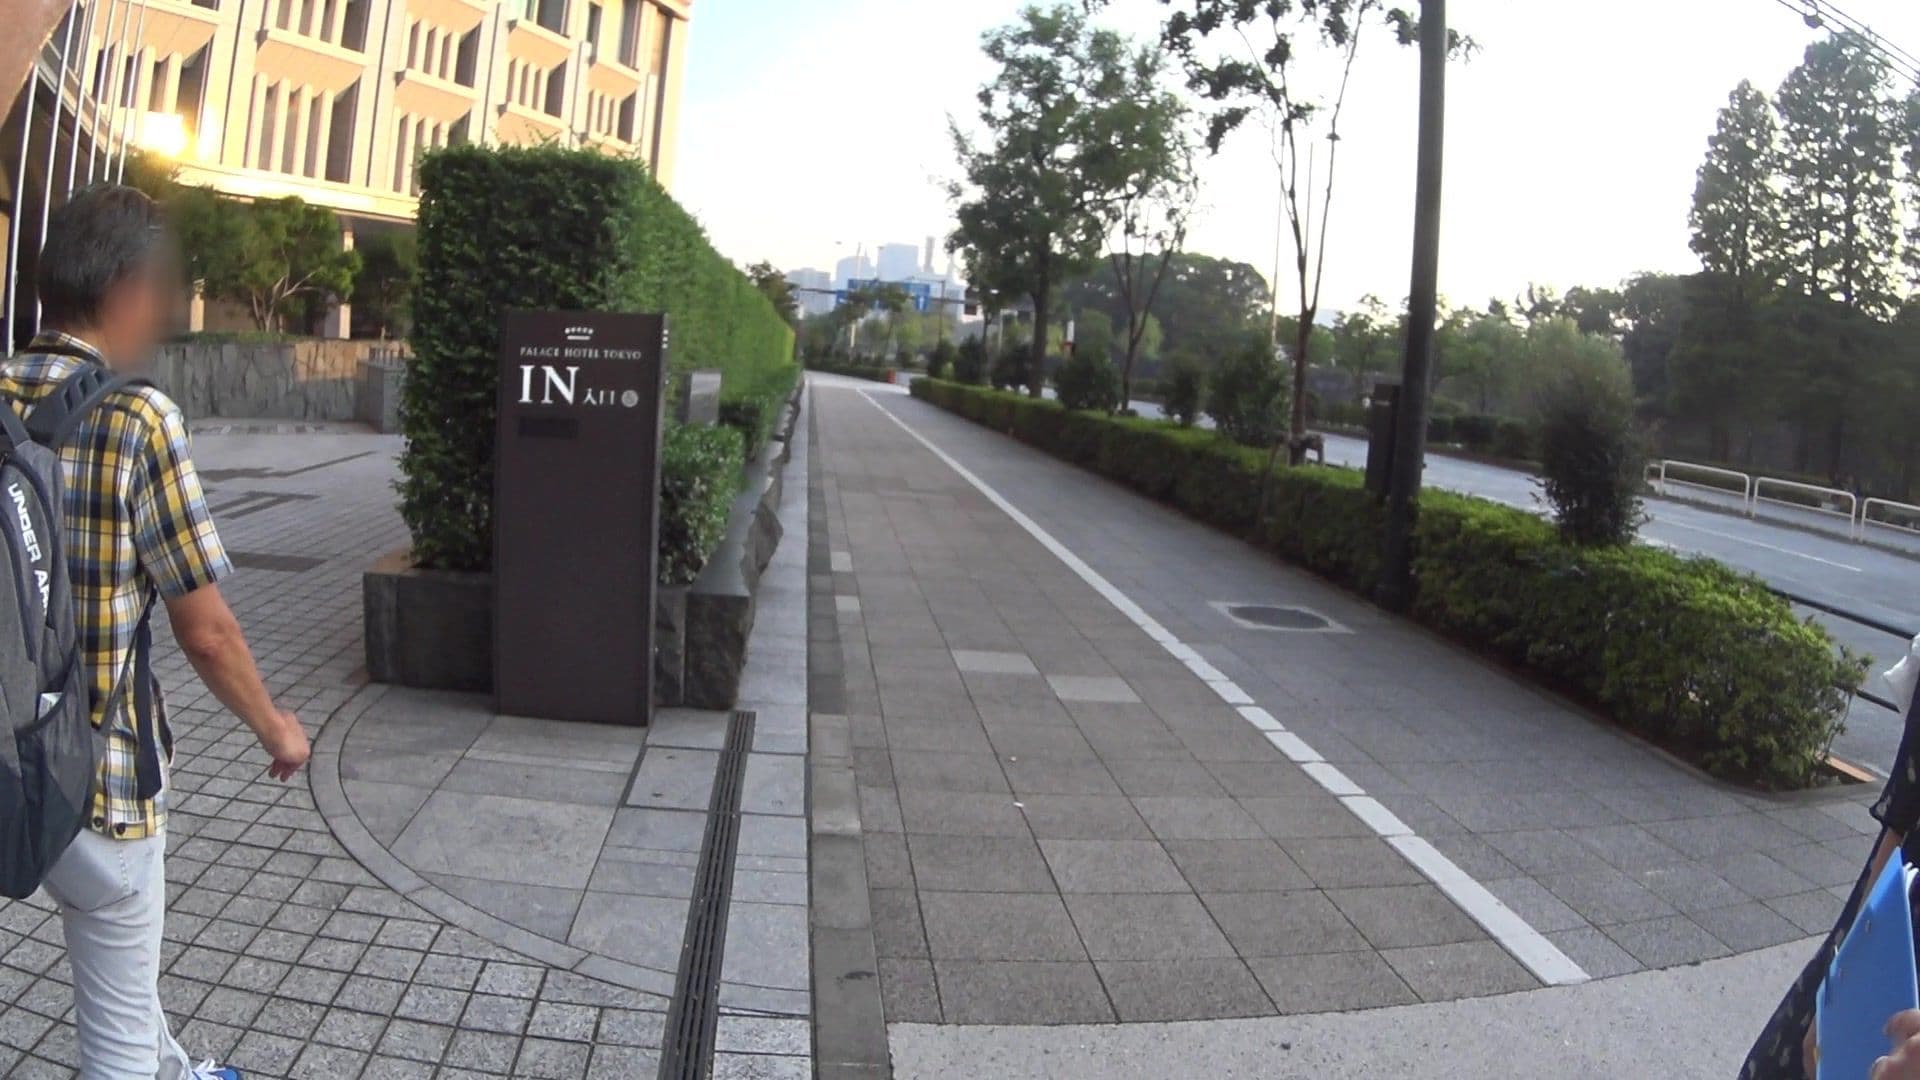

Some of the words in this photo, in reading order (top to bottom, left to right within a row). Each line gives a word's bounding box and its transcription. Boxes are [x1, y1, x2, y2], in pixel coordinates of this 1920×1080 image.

[519, 347, 560, 357] PALACE
[564, 347, 599, 358] HOTEL
[603, 349, 642, 360] TOKYO
[518, 365, 580, 405] IN
[8, 483, 42, 562] UNDER
